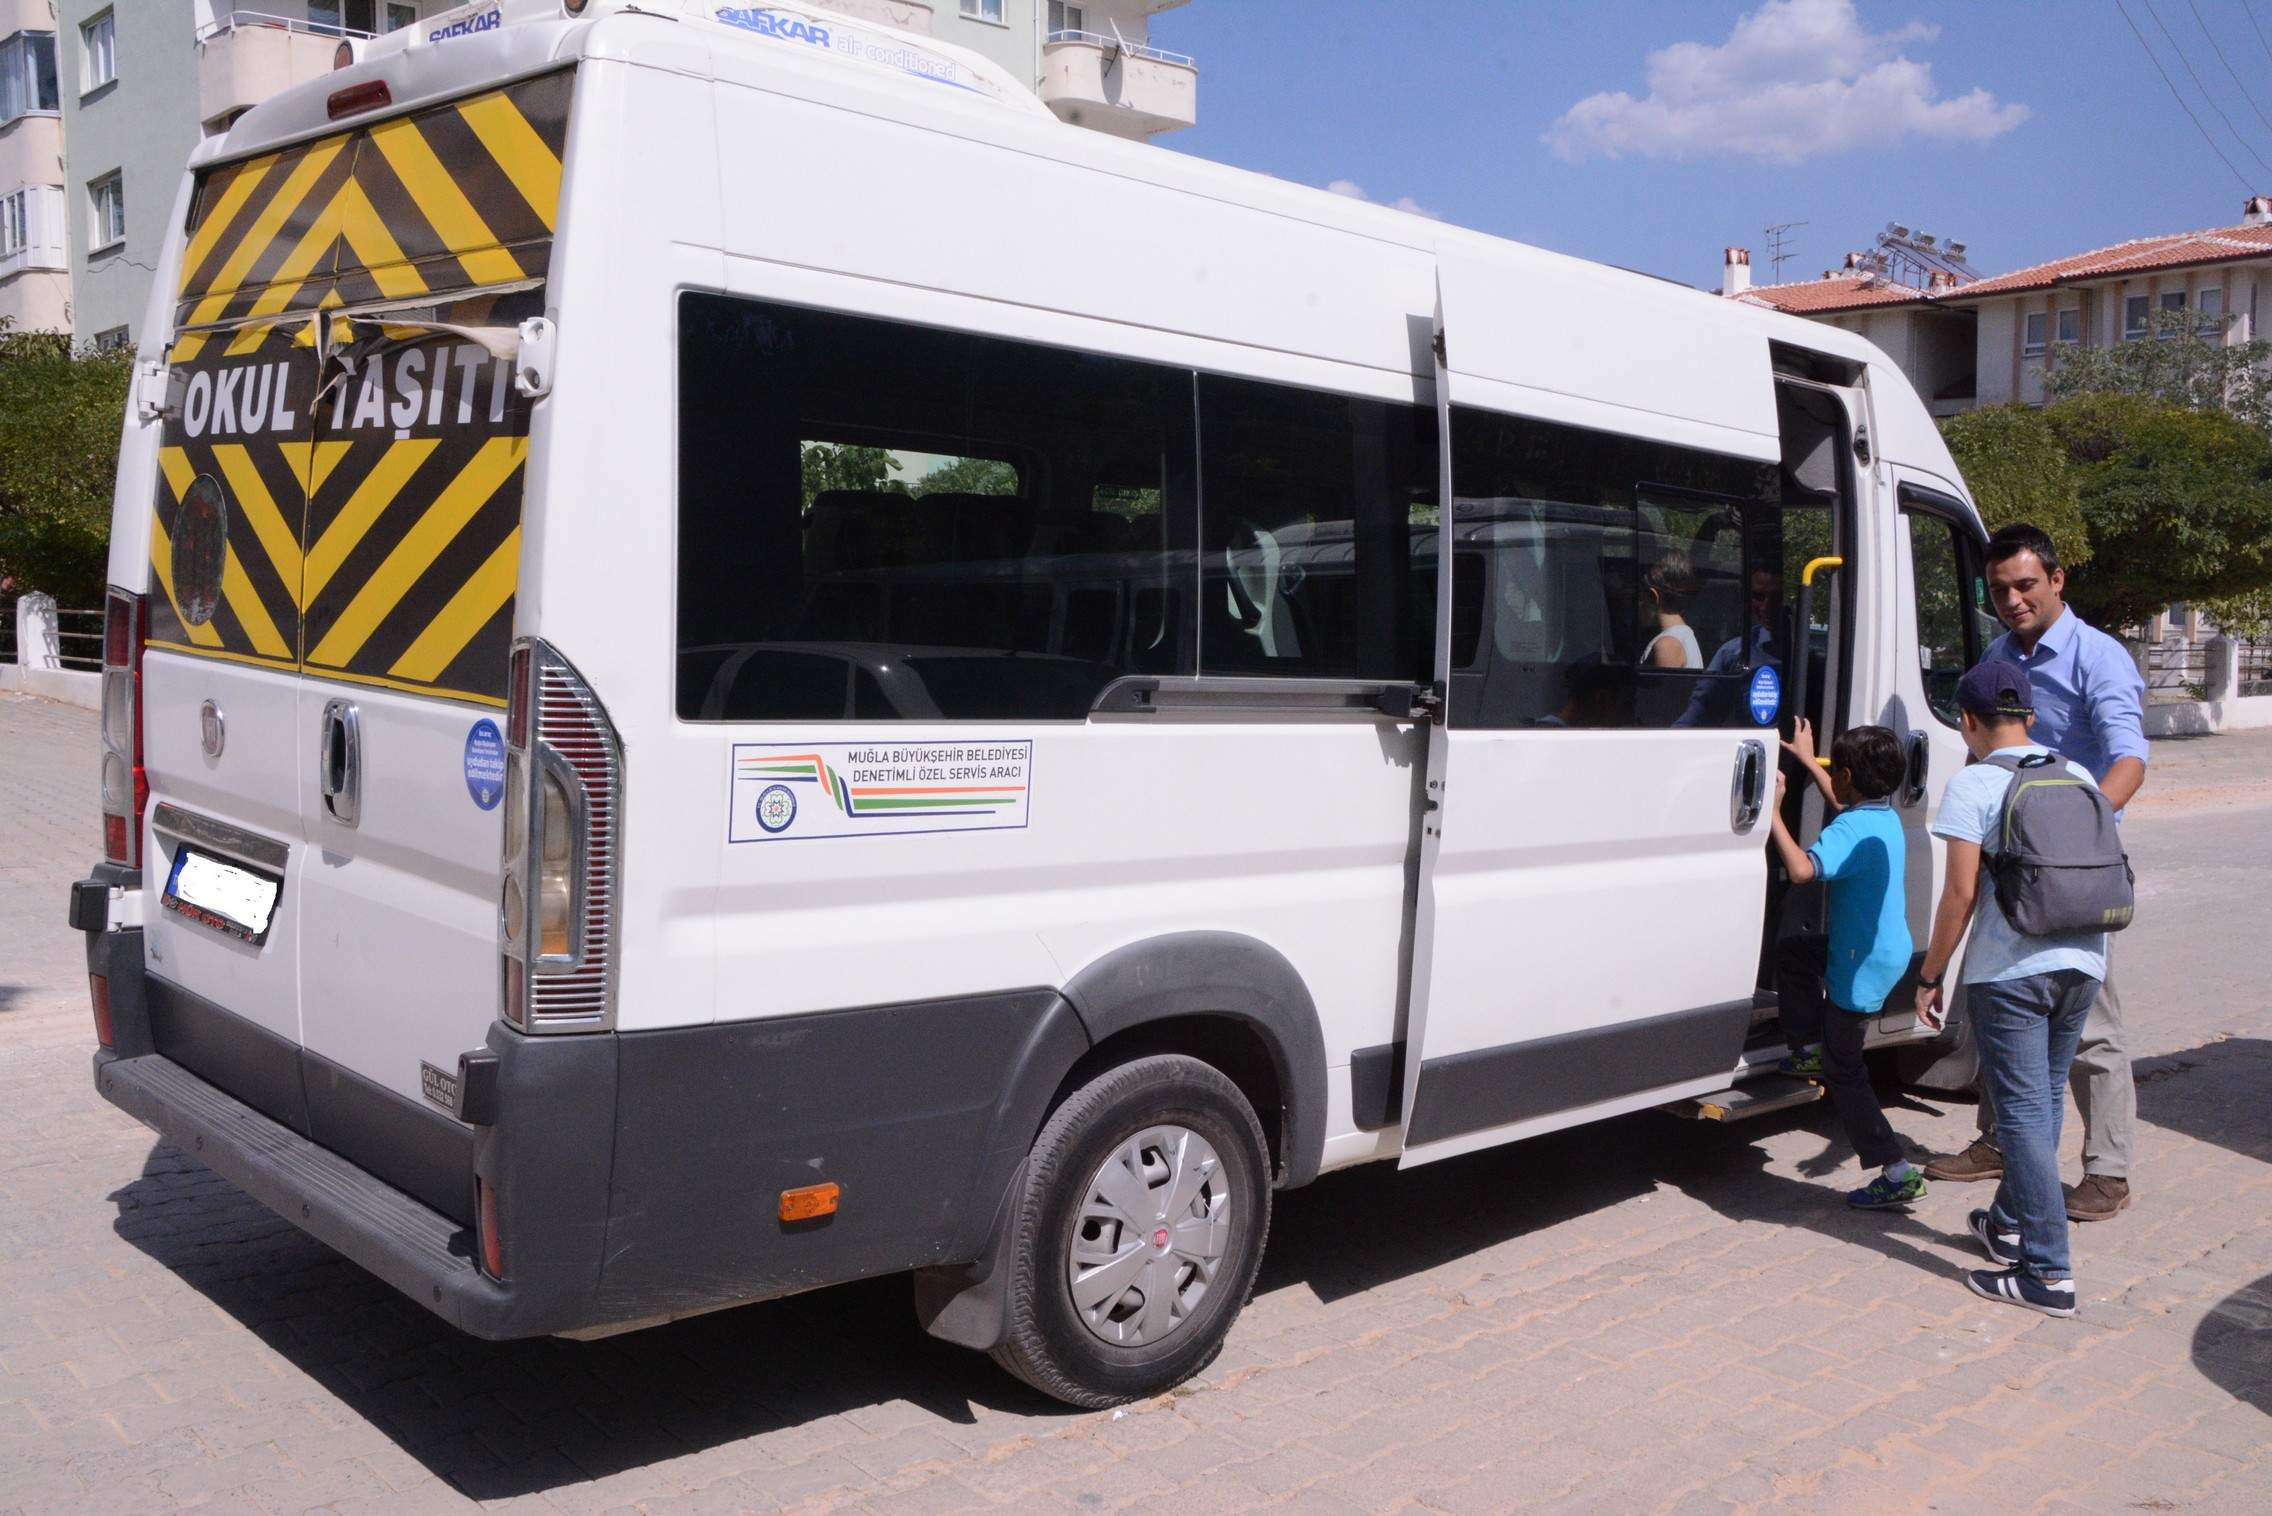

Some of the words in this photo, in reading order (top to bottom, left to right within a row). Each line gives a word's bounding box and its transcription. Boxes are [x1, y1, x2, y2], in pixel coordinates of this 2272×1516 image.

[715, 6, 830, 48] SAFKAR
[838, 35, 861, 56] air
[866, 44, 957, 81] conditioned
[184, 361, 295, 438] OKUL
[848, 748, 890, 764] MUĞLA
[893, 747, 964, 764] BÜYÜKŞEHİR
[967, 745, 1027, 761] BELEDİYESİ
[853, 766, 916, 782] DENETİMLİ
[918, 766, 946, 781] ÖZEL
[949, 764, 987, 780] SERVİS
[989, 766, 1022, 779] ARACI
